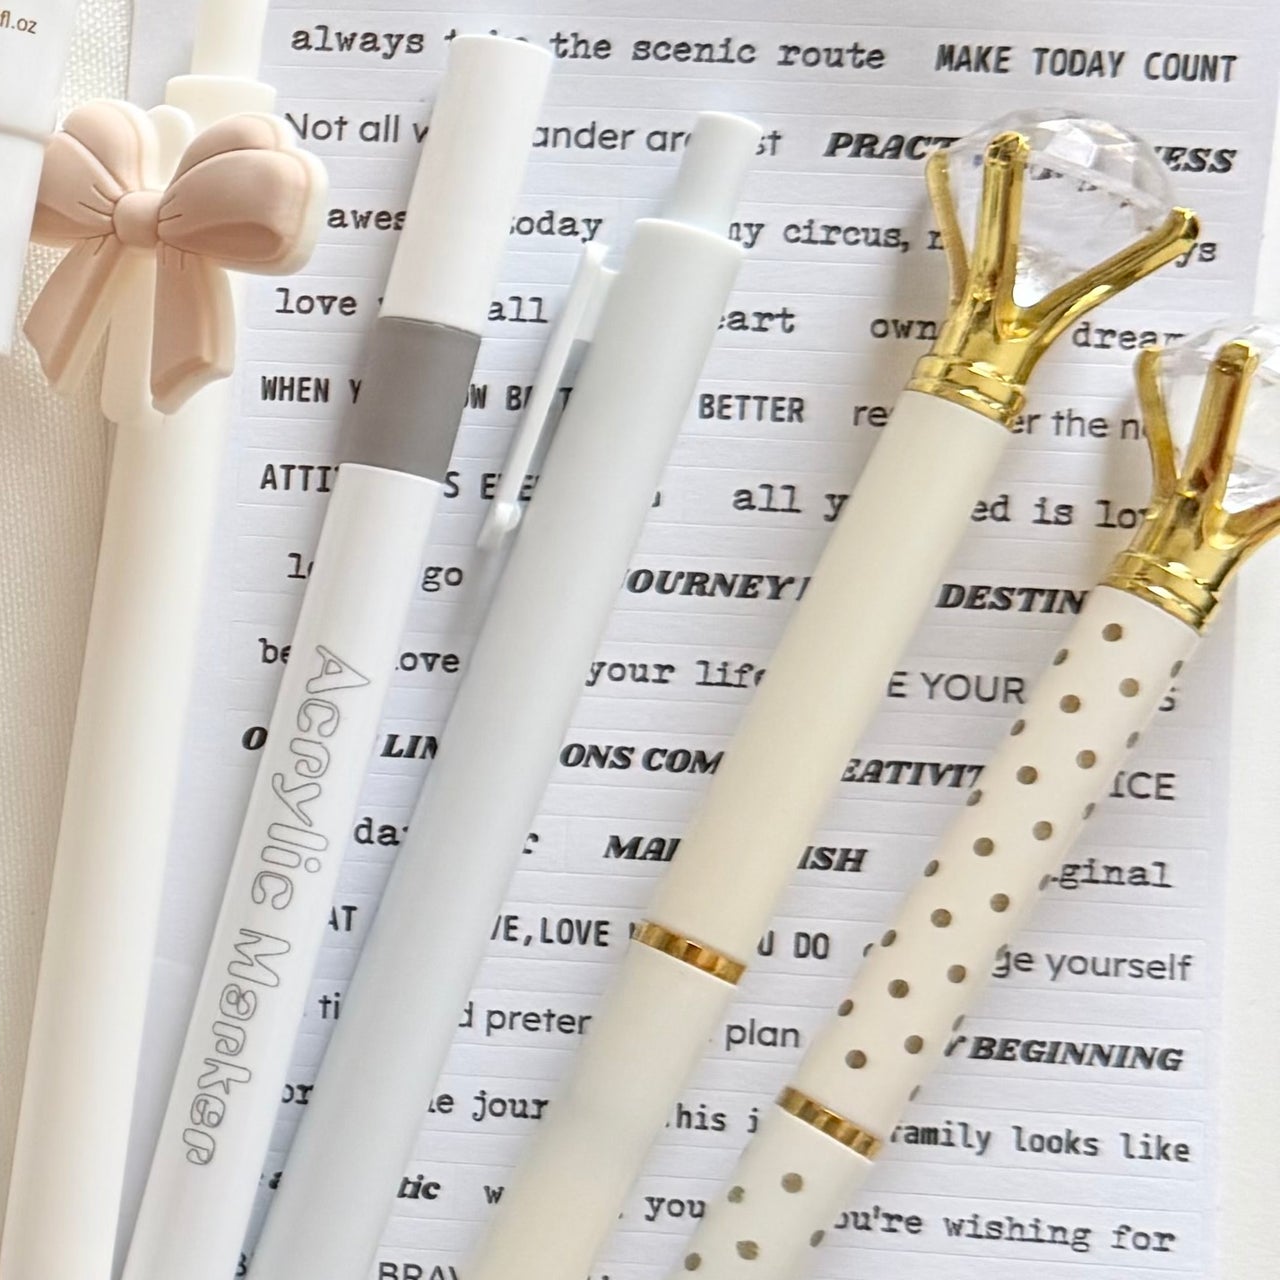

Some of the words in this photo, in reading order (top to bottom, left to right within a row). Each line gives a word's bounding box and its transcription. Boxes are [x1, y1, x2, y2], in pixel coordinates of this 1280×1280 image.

[291, 24, 425, 60] always
[549, 31, 612, 60] the
[631, 37, 757, 66] scenic
[776, 41, 887, 70] route
[934, 43, 1011, 75] MAKE
[1032, 46, 1127, 79] TODAY
[1143, 51, 1238, 84] COUNT
[358, 113, 400, 144] all
[532, 120, 636, 151] ander
[509, 209, 604, 244] oday
[783, 220, 911, 254] circus,
[275, 287, 358, 316] love
[487, 296, 549, 323] all
[870, 317, 939, 342] own
[260, 376, 329, 404] WHEN
[699, 393, 805, 424] BETTER
[1051, 408, 1109, 439] the
[731, 483, 803, 513] all
[1032, 497, 1074, 526] is
[421, 565, 464, 593] go
[622, 567, 796, 601] OURNEY
[935, 581, 1088, 616] DESTIN
[395, 651, 460, 674] ove
[585, 660, 676, 688] your
[921, 672, 1026, 705] YOUR
[251, 644, 371, 911] Acrylic
[796, 845, 869, 874] ISH
[1051, 857, 1173, 891] ginal
[792, 931, 830, 959] DO
[1045, 953, 1193, 982] yourself
[182, 927, 292, 1166] Marker
[725, 1018, 800, 1051] plan
[966, 1034, 1185, 1073] BEGINNING
[471, 1089, 549, 1122] jour
[1012, 1125, 1099, 1159] looks
[1122, 1132, 1191, 1163] like
[942, 1215, 1093, 1253] wishing
[1110, 1224, 1176, 1252] for
